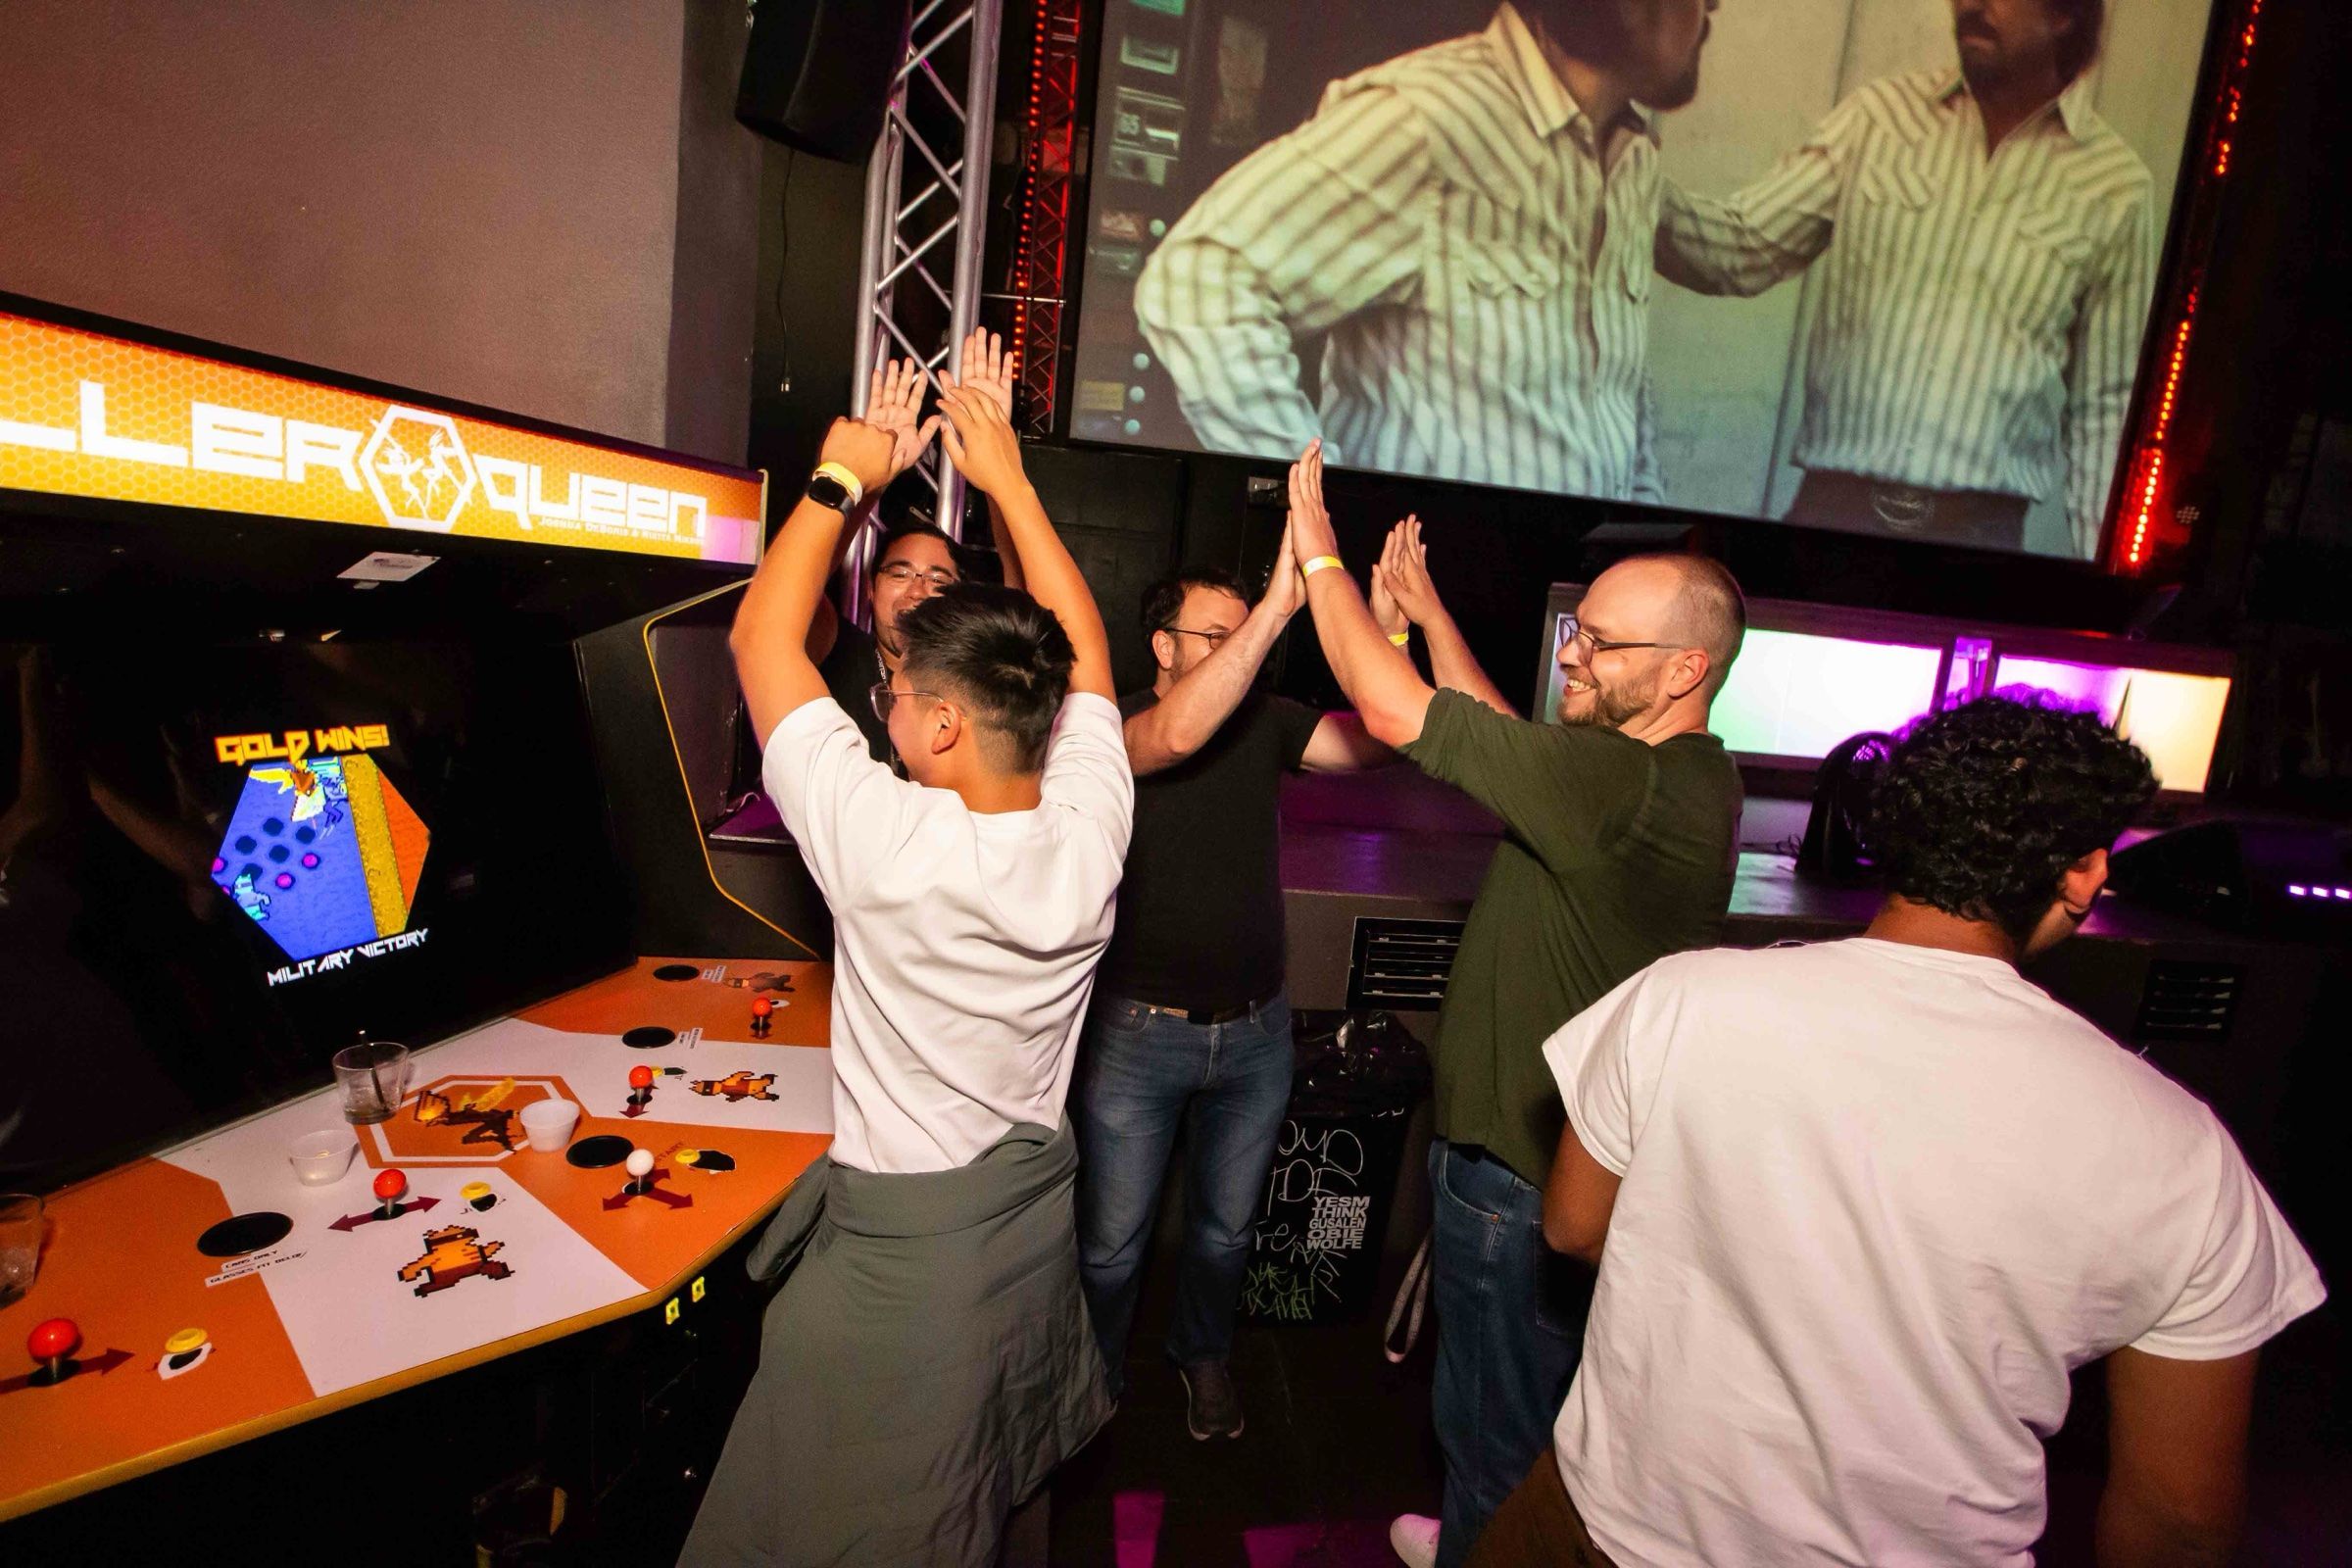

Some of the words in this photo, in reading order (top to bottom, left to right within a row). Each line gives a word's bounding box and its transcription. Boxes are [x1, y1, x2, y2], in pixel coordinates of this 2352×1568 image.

[215, 731, 311, 765] GOLD
[315, 724, 390, 754] WINS!
[267, 949, 354, 986] MILITARY
[357, 928, 428, 958] VICTORY
[1314, 1196, 1370, 1207] YESM
[1311, 1206, 1368, 1218] THINK
[1309, 1217, 1366, 1229] GUSALEN
[1307, 1228, 1364, 1240] OBIE
[1306, 1238, 1362, 1250] WOLFE
[210, 1267, 253, 1283] GLASSES
